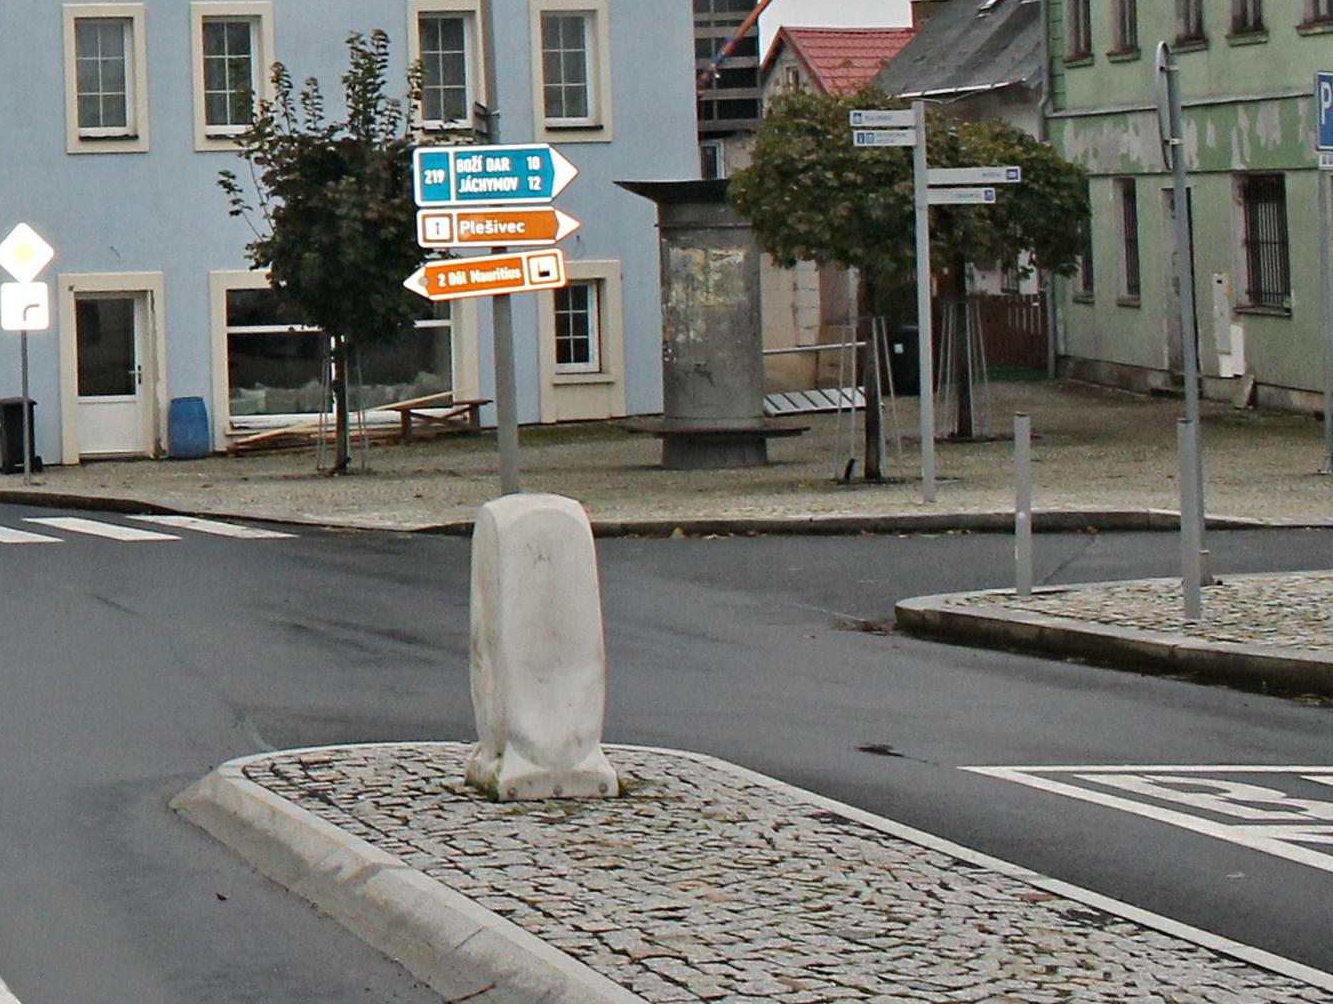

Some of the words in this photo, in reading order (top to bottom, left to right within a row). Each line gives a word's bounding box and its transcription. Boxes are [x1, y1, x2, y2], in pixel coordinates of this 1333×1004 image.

[1321, 81, 1332, 125] P
[456, 155, 482, 173] BOŽÍ
[486, 157, 510, 172] DAR
[526, 156, 540, 170] 10
[424, 170, 445, 185] 219
[458, 175, 518, 193] JÁCHYMOV
[527, 176, 541, 190] 12
[460, 219, 525, 235] Plešivec
[437, 273, 446, 287] 2
[469, 266, 521, 283] Mauritius
